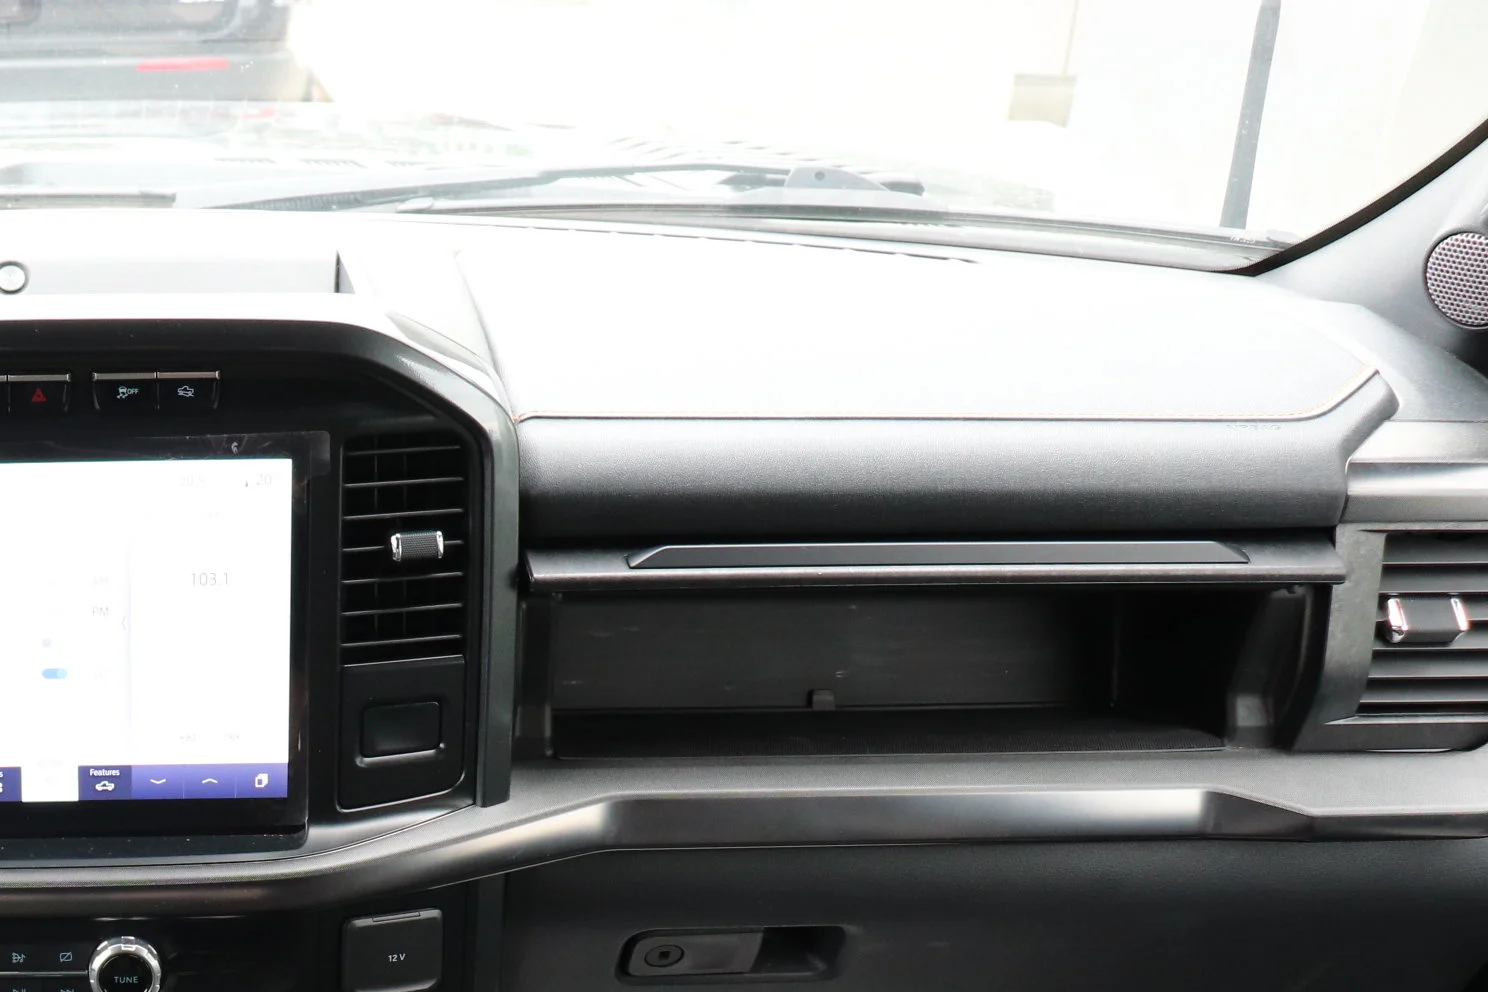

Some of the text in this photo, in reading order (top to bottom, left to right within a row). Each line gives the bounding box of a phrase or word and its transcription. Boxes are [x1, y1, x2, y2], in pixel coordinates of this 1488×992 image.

[190, 572, 229, 587] 103.1
[91, 606, 110, 618] PM
[90, 768, 120, 777] Features
[387, 954, 398, 962] 12
[113, 976, 139, 984] TUNE
